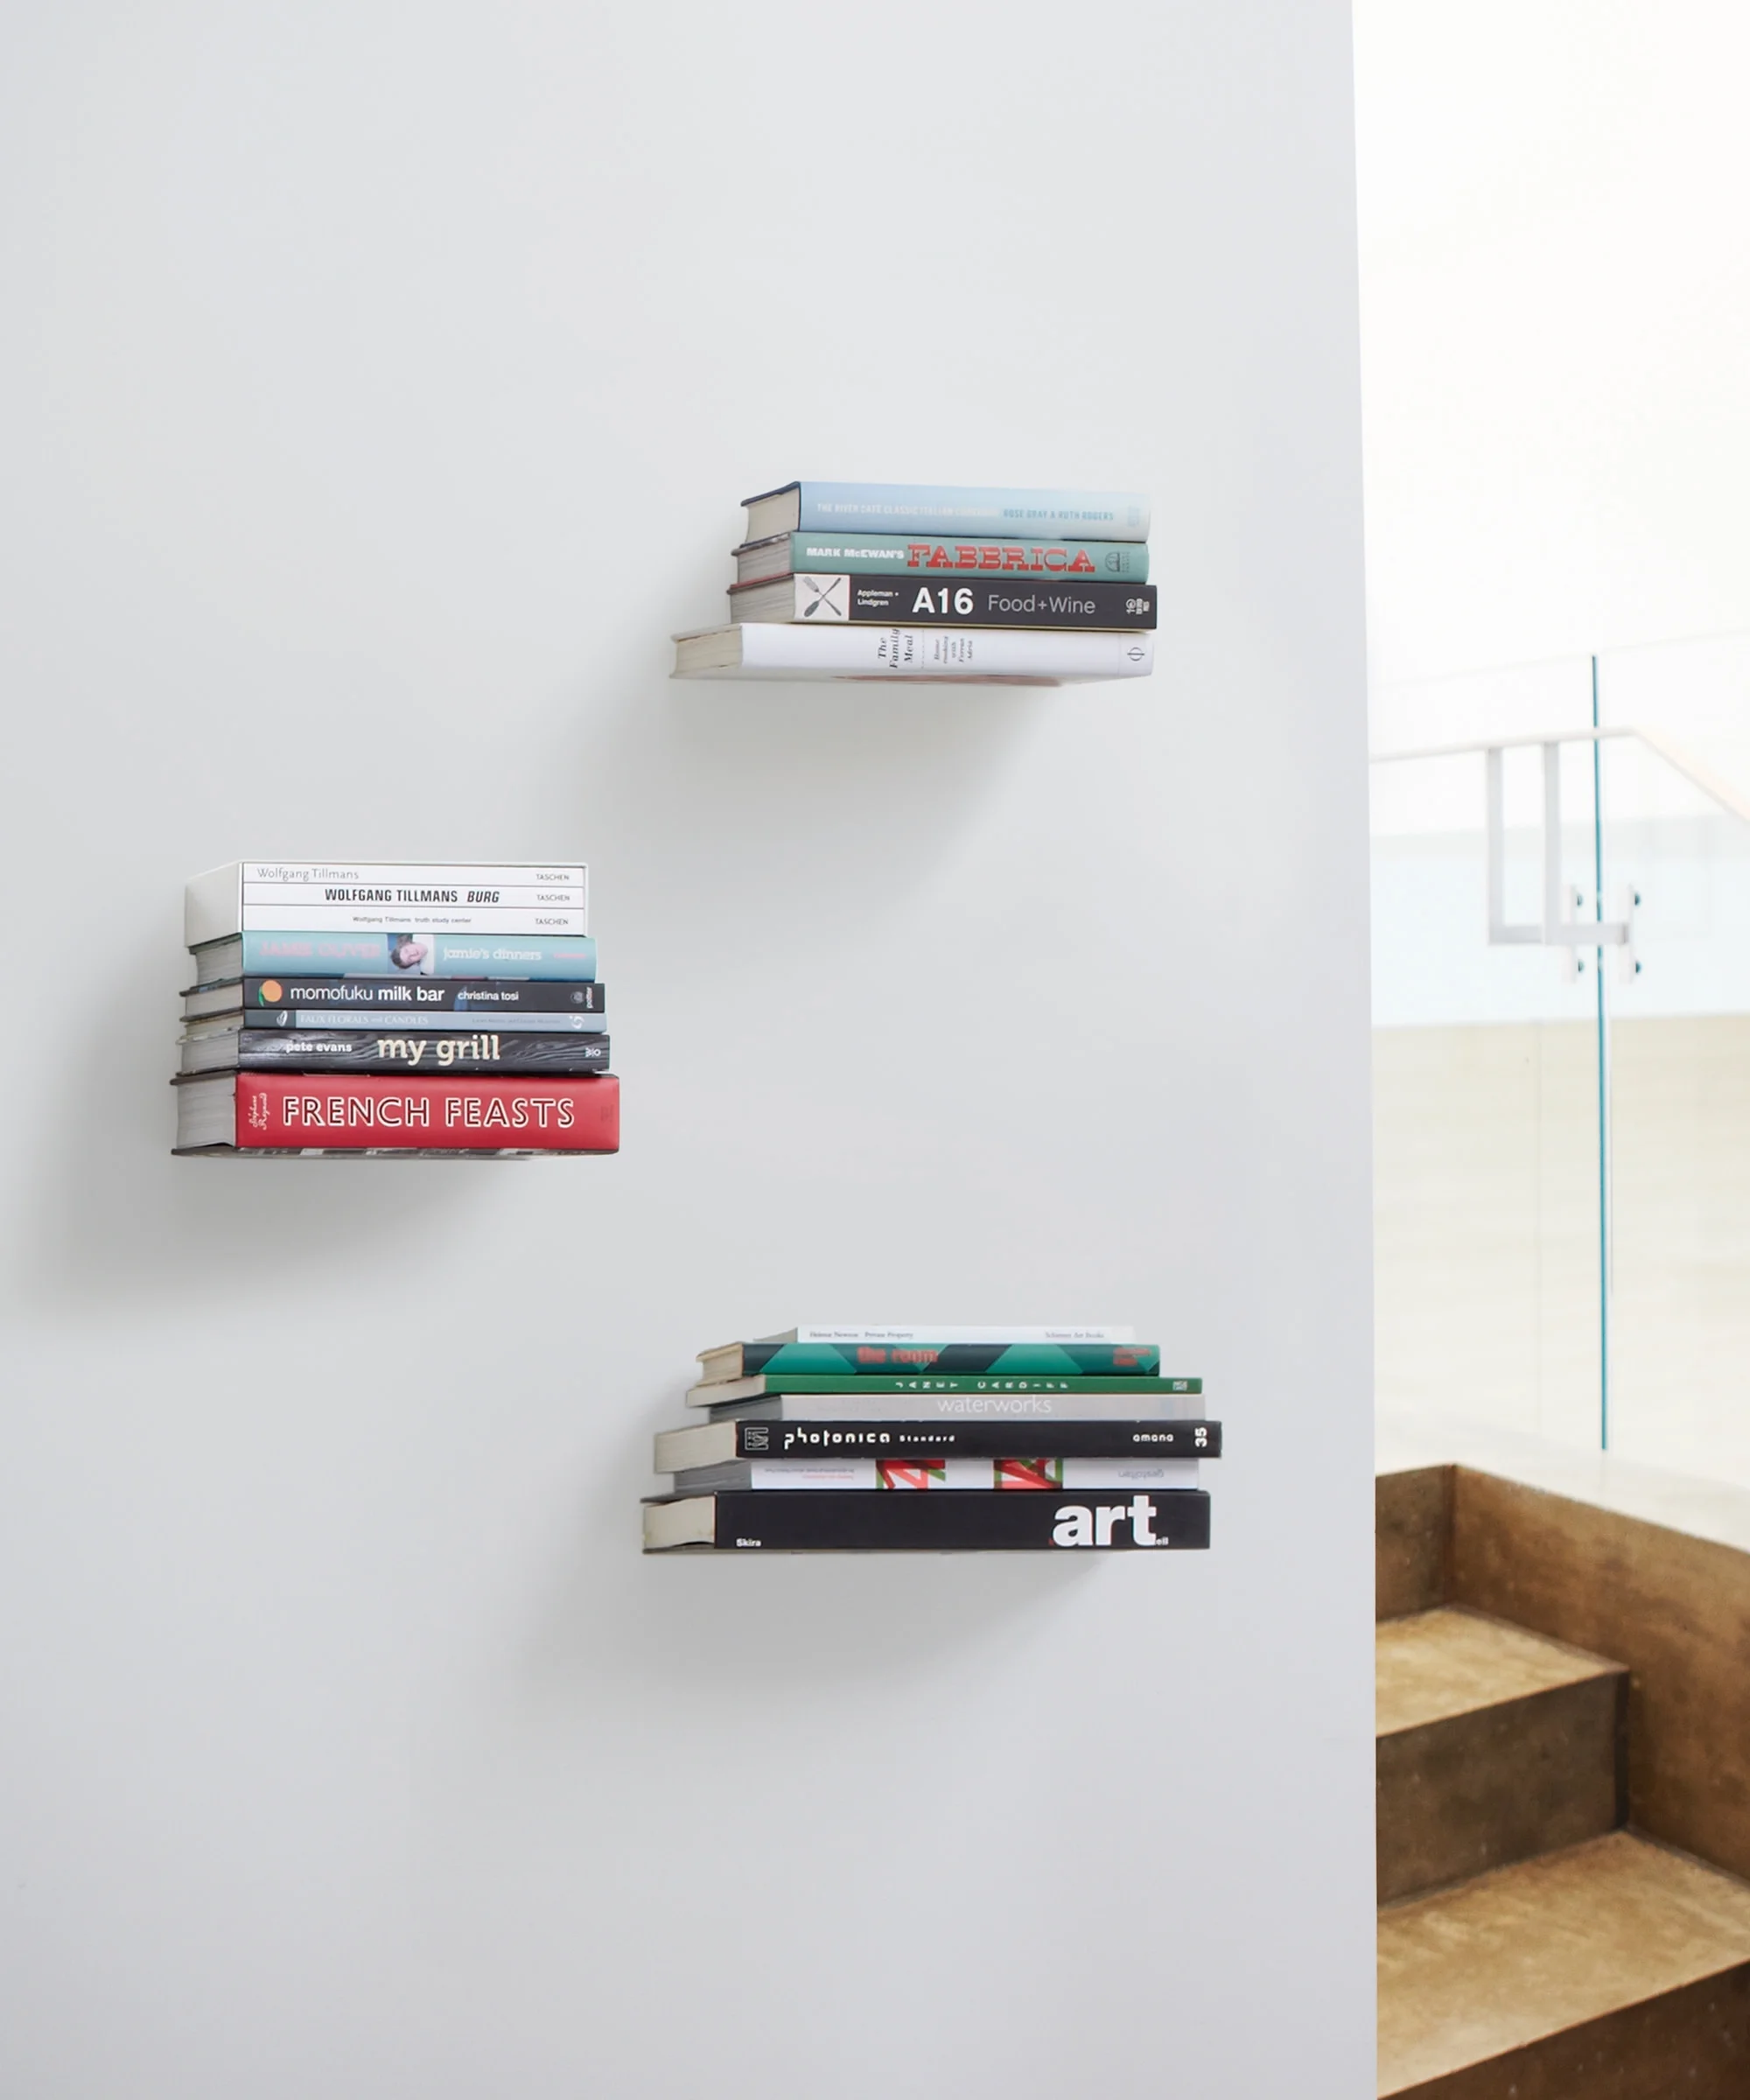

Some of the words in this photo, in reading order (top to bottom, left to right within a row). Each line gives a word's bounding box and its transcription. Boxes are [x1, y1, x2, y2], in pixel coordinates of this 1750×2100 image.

[807, 548, 841, 557] MARK
[844, 549, 905, 560] McEWAN'S
[907, 544, 1096, 572] FABBRICA
[858, 589, 892, 599] Appleman
[913, 587, 973, 615] A16
[858, 599, 889, 609] Lindgren
[878, 637, 887, 659] The
[890, 628, 900, 668] Family
[904, 635, 914, 663] Meal
[257, 868, 310, 881] Wolfgang
[312, 868, 360, 879] Tillmans
[325, 889, 392, 901] WOLFGANG
[397, 889, 458, 902] TILLMANS
[467, 891, 500, 903] BURG
[443, 947, 490, 962] jamie's
[493, 948, 542, 961] dinners
[290, 985, 373, 1001] momofuku
[378, 986, 412, 1001] milk
[416, 986, 445, 1001] bar
[458, 990, 499, 1001] christina
[500, 990, 519, 1001] tosi
[300, 1014, 326, 1024] FAUX
[327, 1014, 369, 1025] FLORALS
[384, 1015, 429, 1026] CANDLES
[286, 1042, 313, 1054] pete
[316, 1043, 353, 1053] evans
[377, 1040, 427, 1066] my
[437, 1035, 500, 1066] grill
[283, 1096, 429, 1128] FRENCH
[445, 1097, 575, 1128] FEASTS
[856, 1346, 886, 1363] the
[895, 1380, 959, 1390] JANET
[937, 1395, 1052, 1413] waterworks
[784, 1427, 891, 1450] photonica
[900, 1434, 956, 1443] Standard
[1132, 1433, 1174, 1443] amana
[1194, 1427, 1208, 1448] 35
[736, 1537, 762, 1547] Skira
